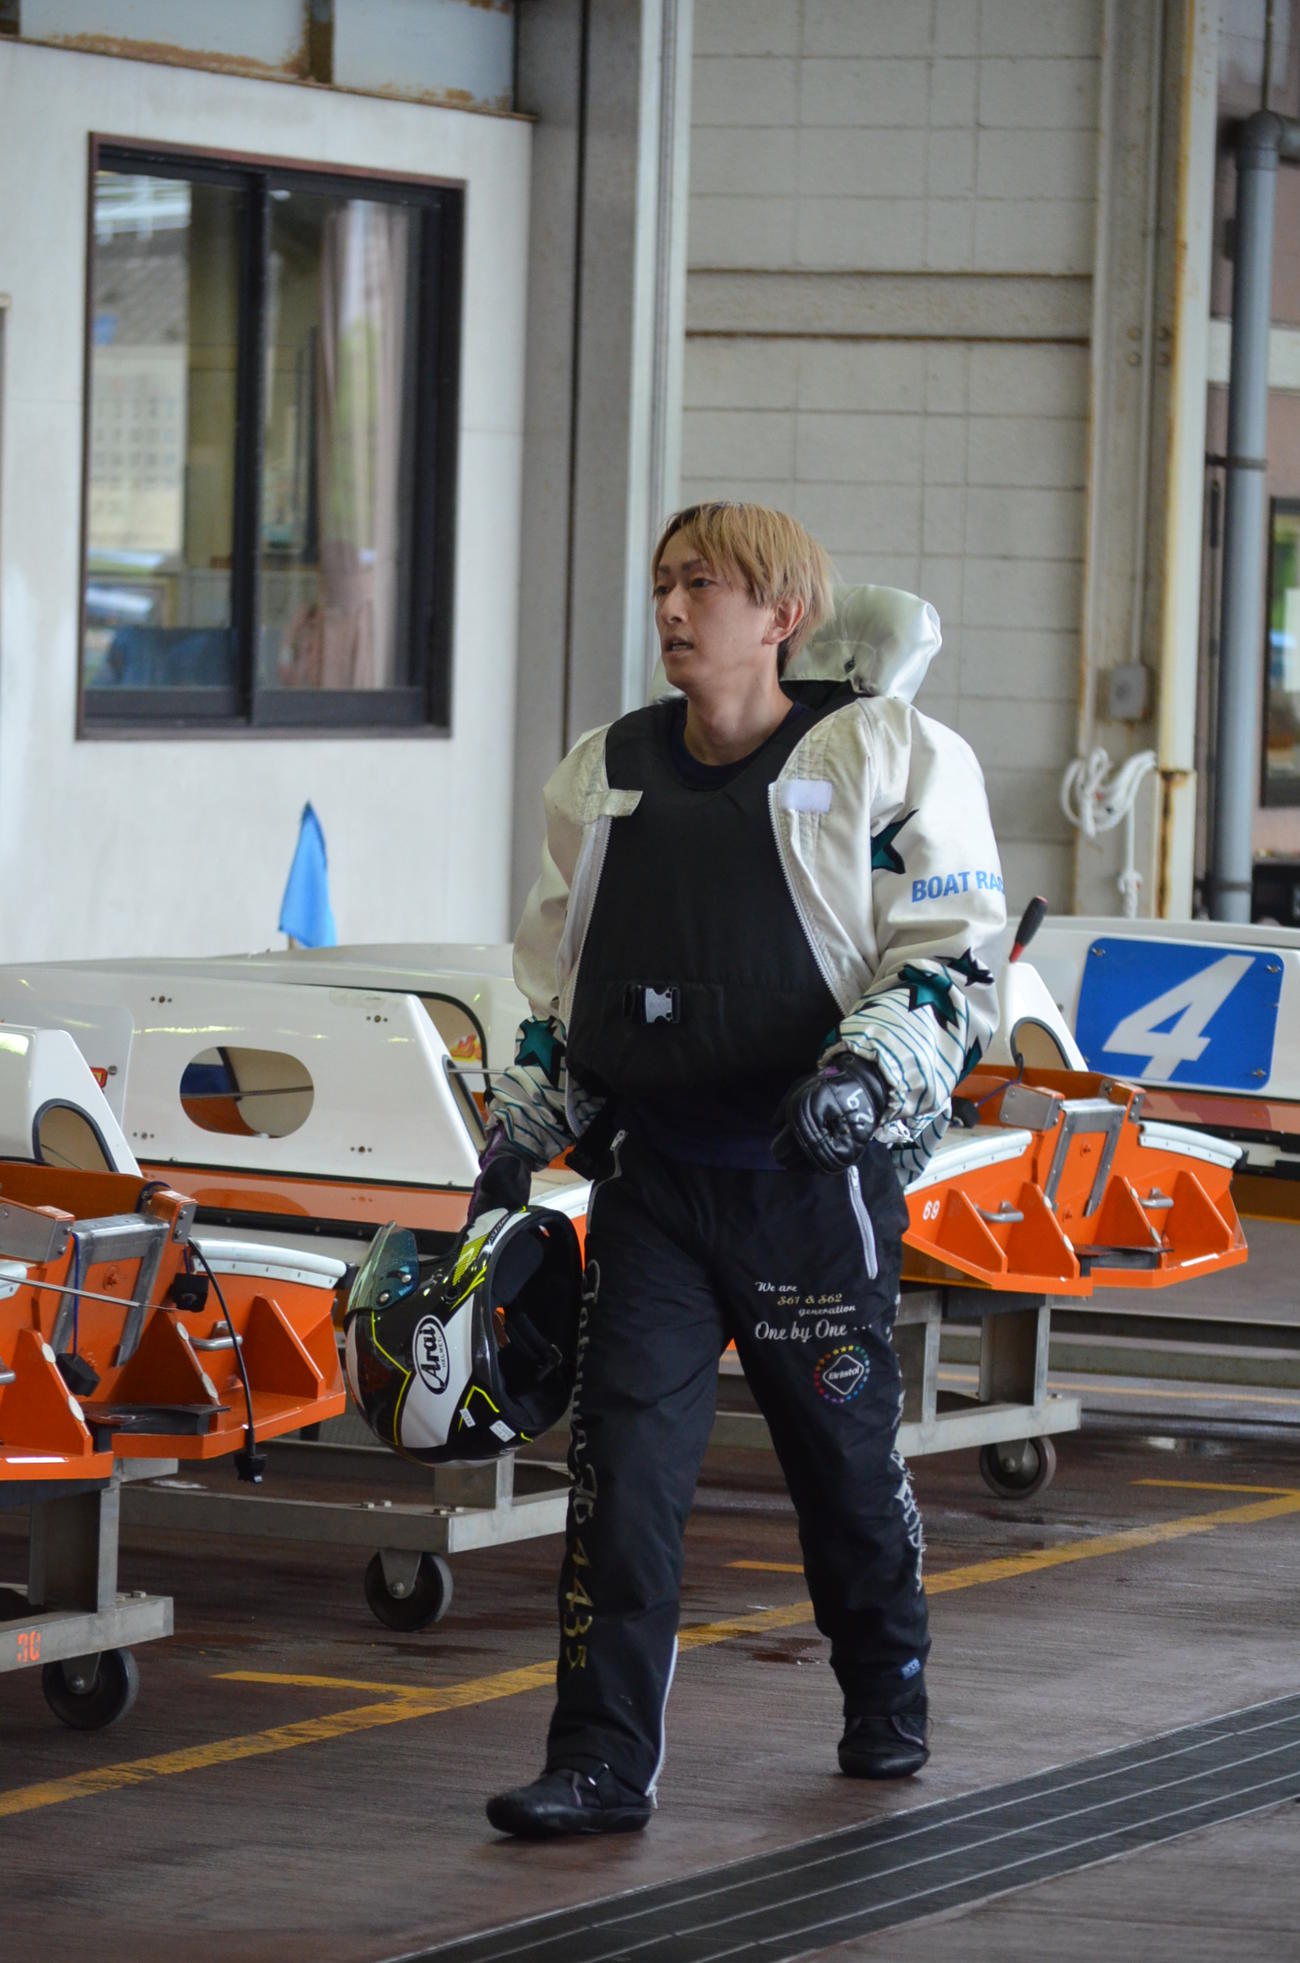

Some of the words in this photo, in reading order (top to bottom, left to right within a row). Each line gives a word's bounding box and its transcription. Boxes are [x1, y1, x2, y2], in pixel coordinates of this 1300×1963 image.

[911, 871, 970, 903] BOAT
[1102, 953, 1256, 1081] 4
[922, 1200, 940, 1221] 69
[755, 1281, 775, 1292] We
[798, 1304, 856, 1317] generation
[805, 1295, 815, 1304] &
[755, 1320, 788, 1341] One
[790, 1320, 812, 1343] by
[815, 1319, 848, 1338] One
[419, 1325, 446, 1389] Arai
[563, 1536, 594, 1669] 4435
